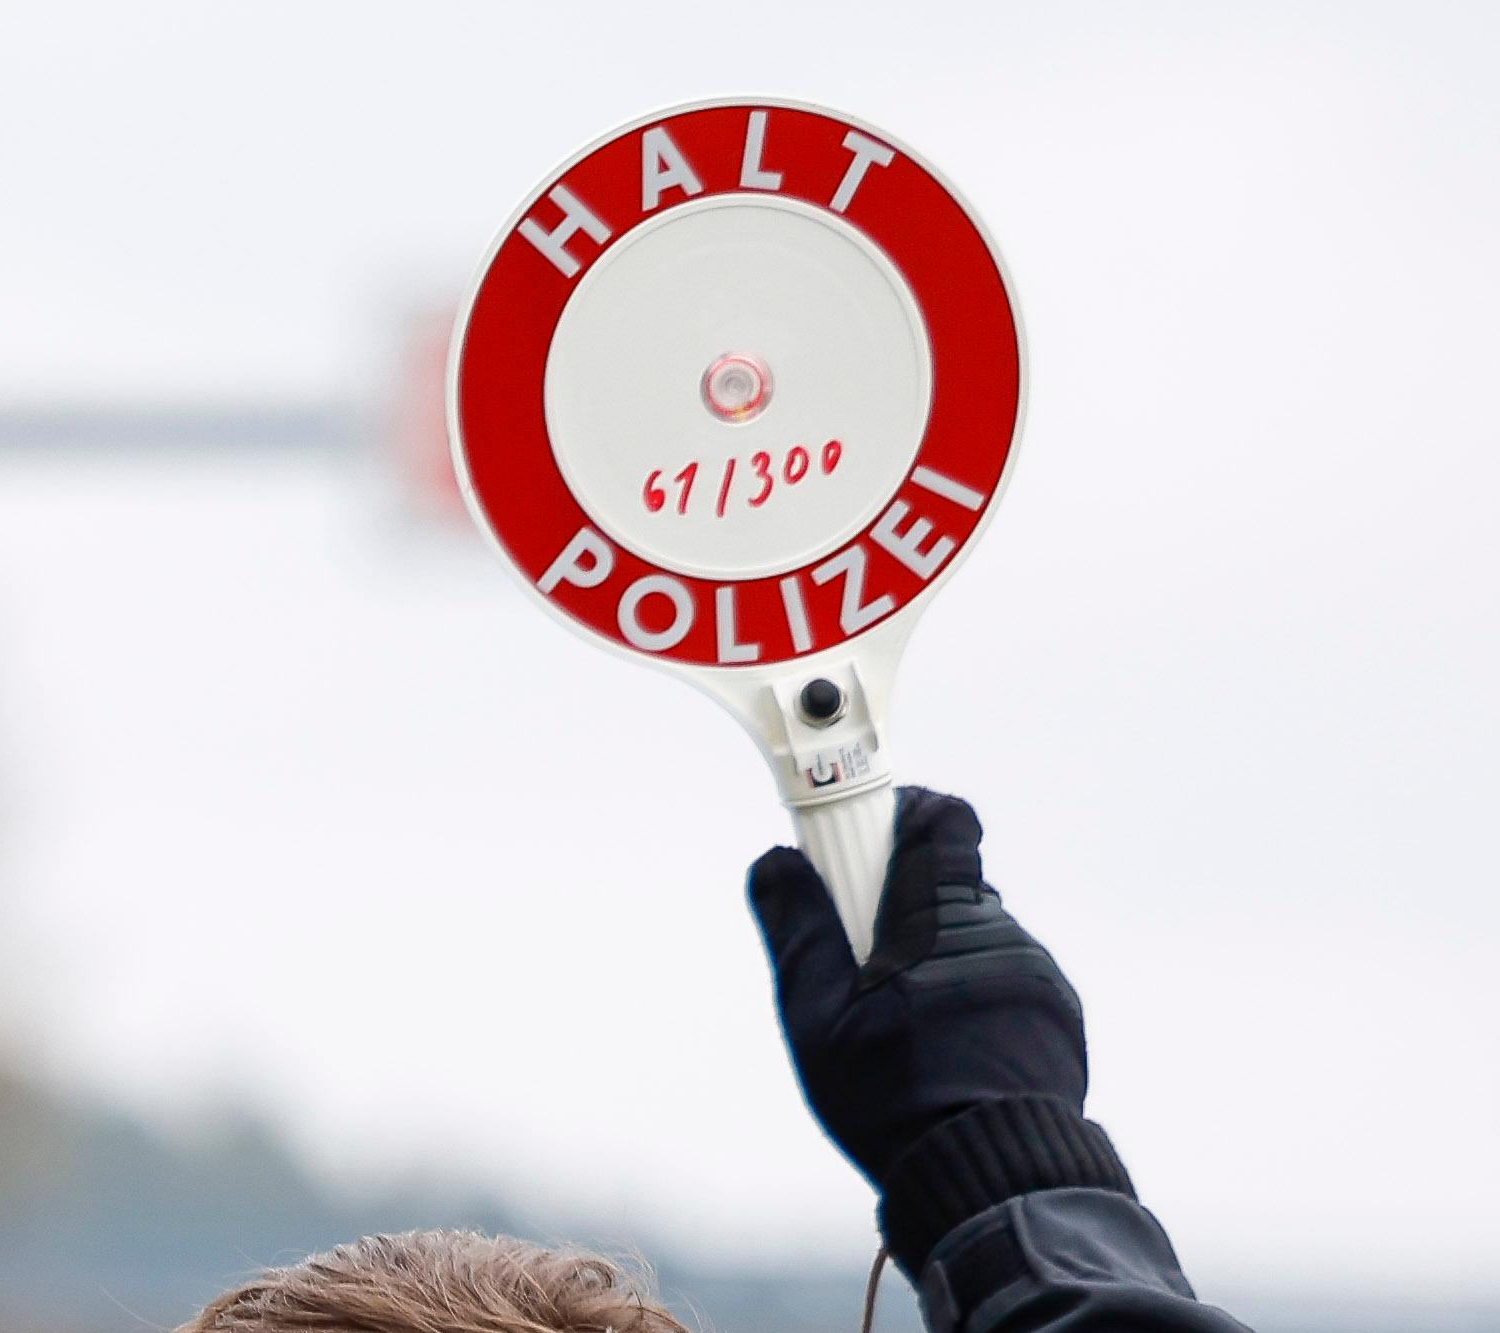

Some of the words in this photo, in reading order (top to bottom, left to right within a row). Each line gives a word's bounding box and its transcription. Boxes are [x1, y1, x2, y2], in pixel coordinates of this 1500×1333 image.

[518, 110, 895, 279] HALT
[643, 438, 844, 518] 61/300
[536, 466, 985, 664] POLIZEI
